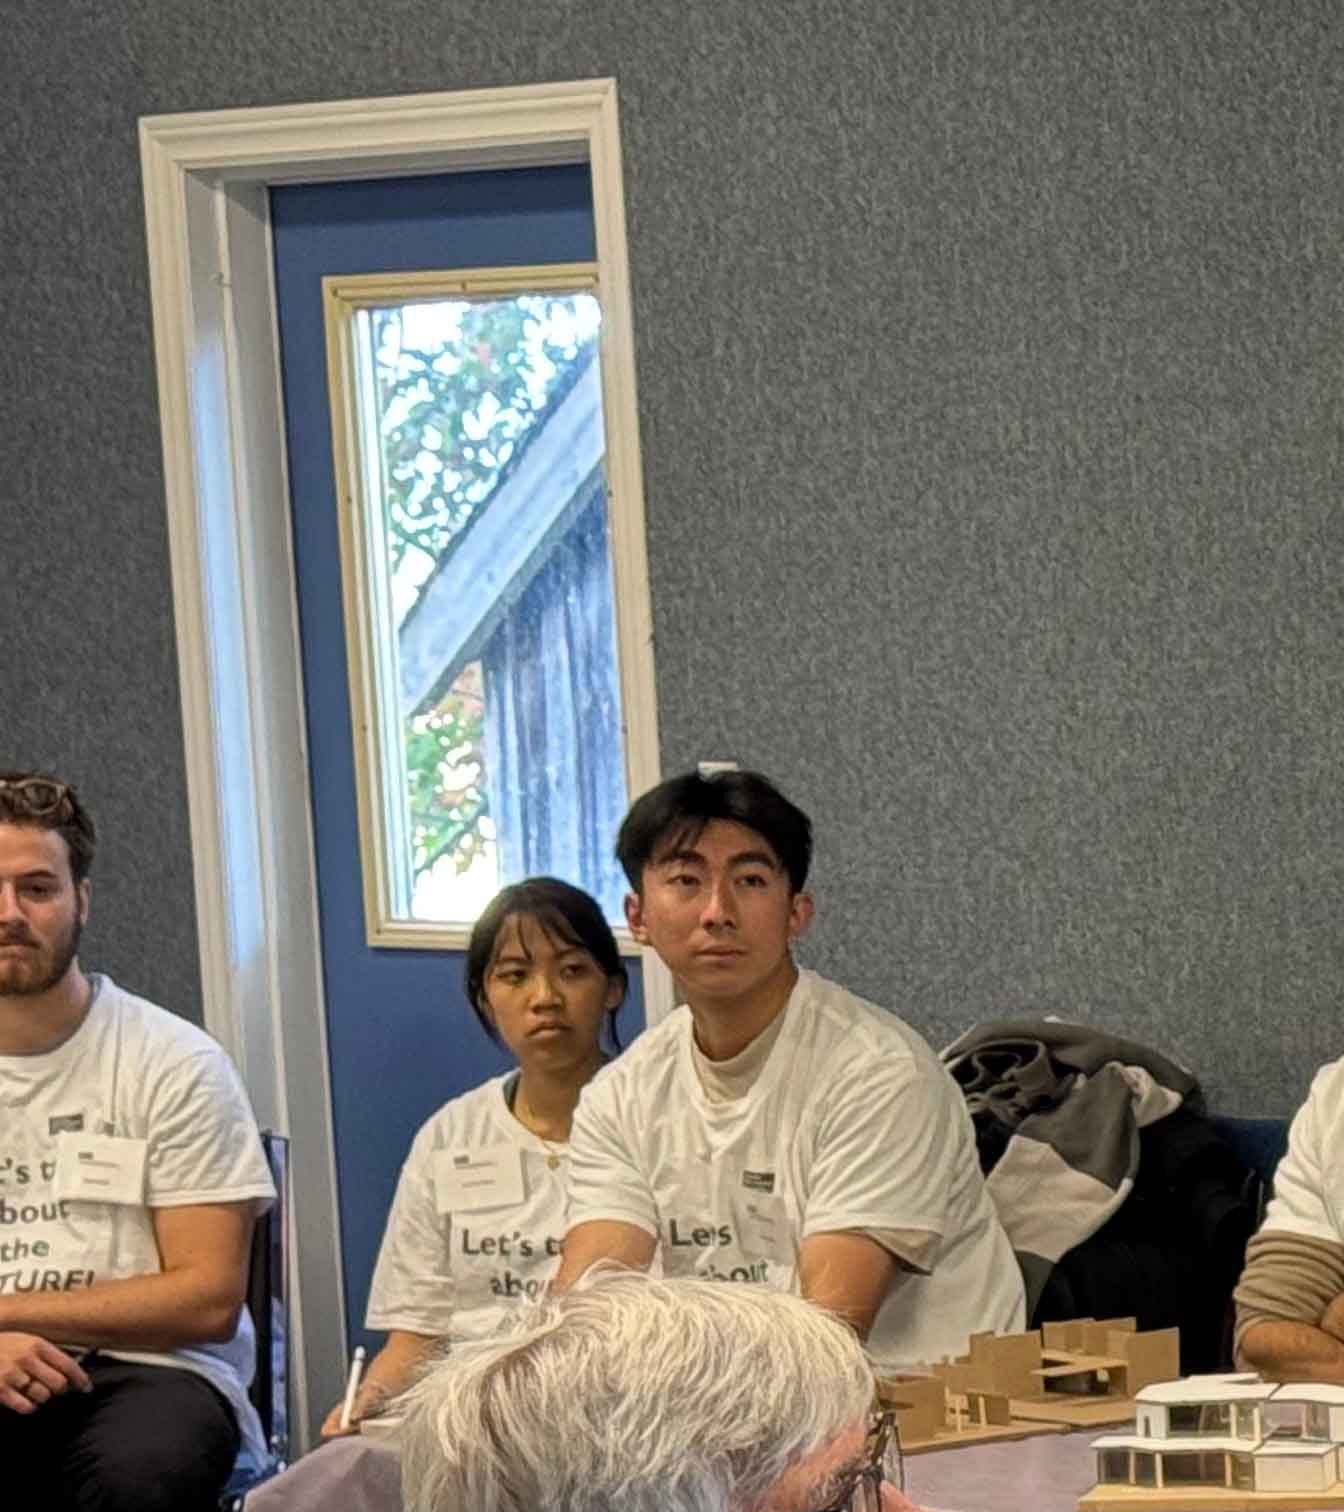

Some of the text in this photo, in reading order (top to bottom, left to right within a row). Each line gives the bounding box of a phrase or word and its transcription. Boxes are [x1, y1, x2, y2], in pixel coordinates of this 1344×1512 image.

[0, 1197, 70, 1225] bout
[0, 1238, 51, 1263] the
[462, 1228, 533, 1257] Let's
